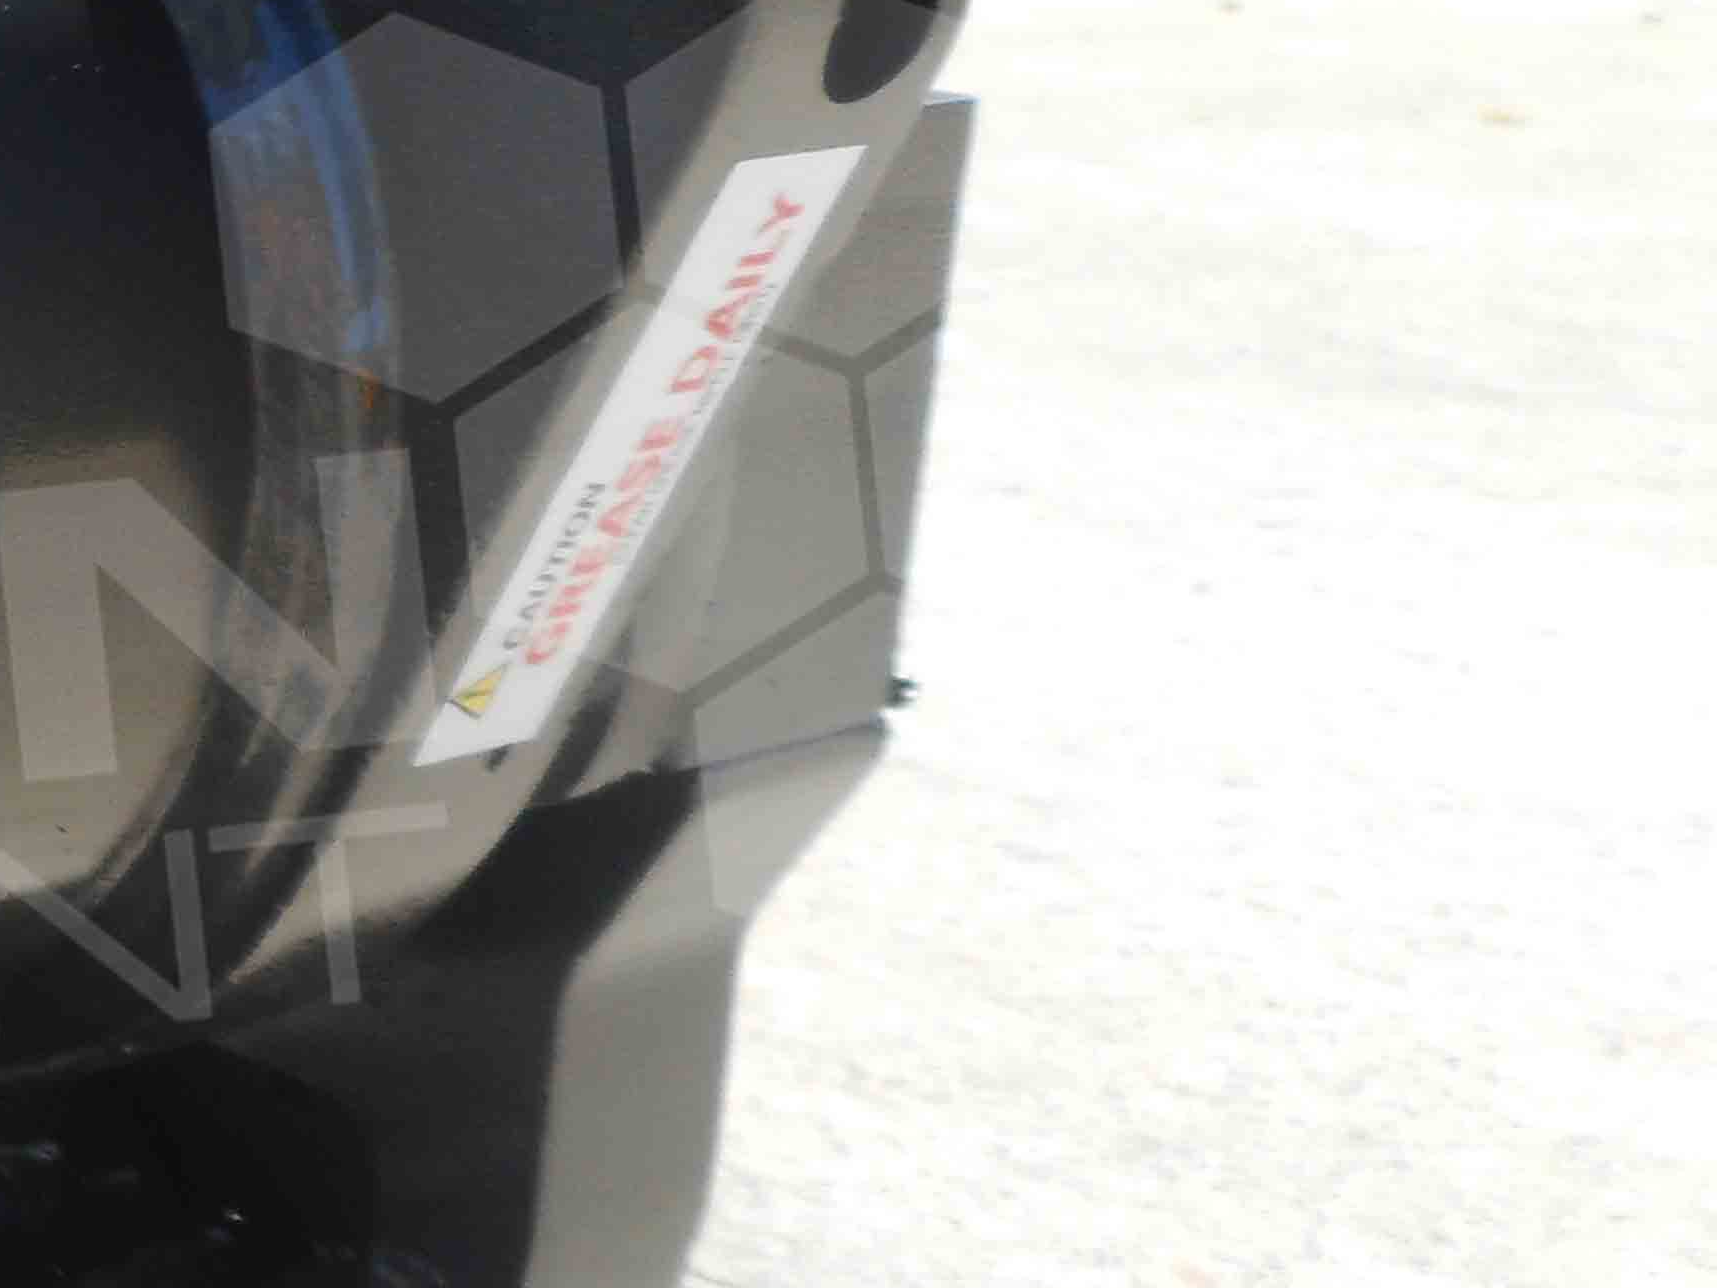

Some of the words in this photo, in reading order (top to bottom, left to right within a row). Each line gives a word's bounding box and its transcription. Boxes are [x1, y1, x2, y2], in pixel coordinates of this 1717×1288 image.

[502, 482, 607, 651] CAUTION
[523, 414, 685, 667] GREASE
[670, 192, 805, 396] DAILY
